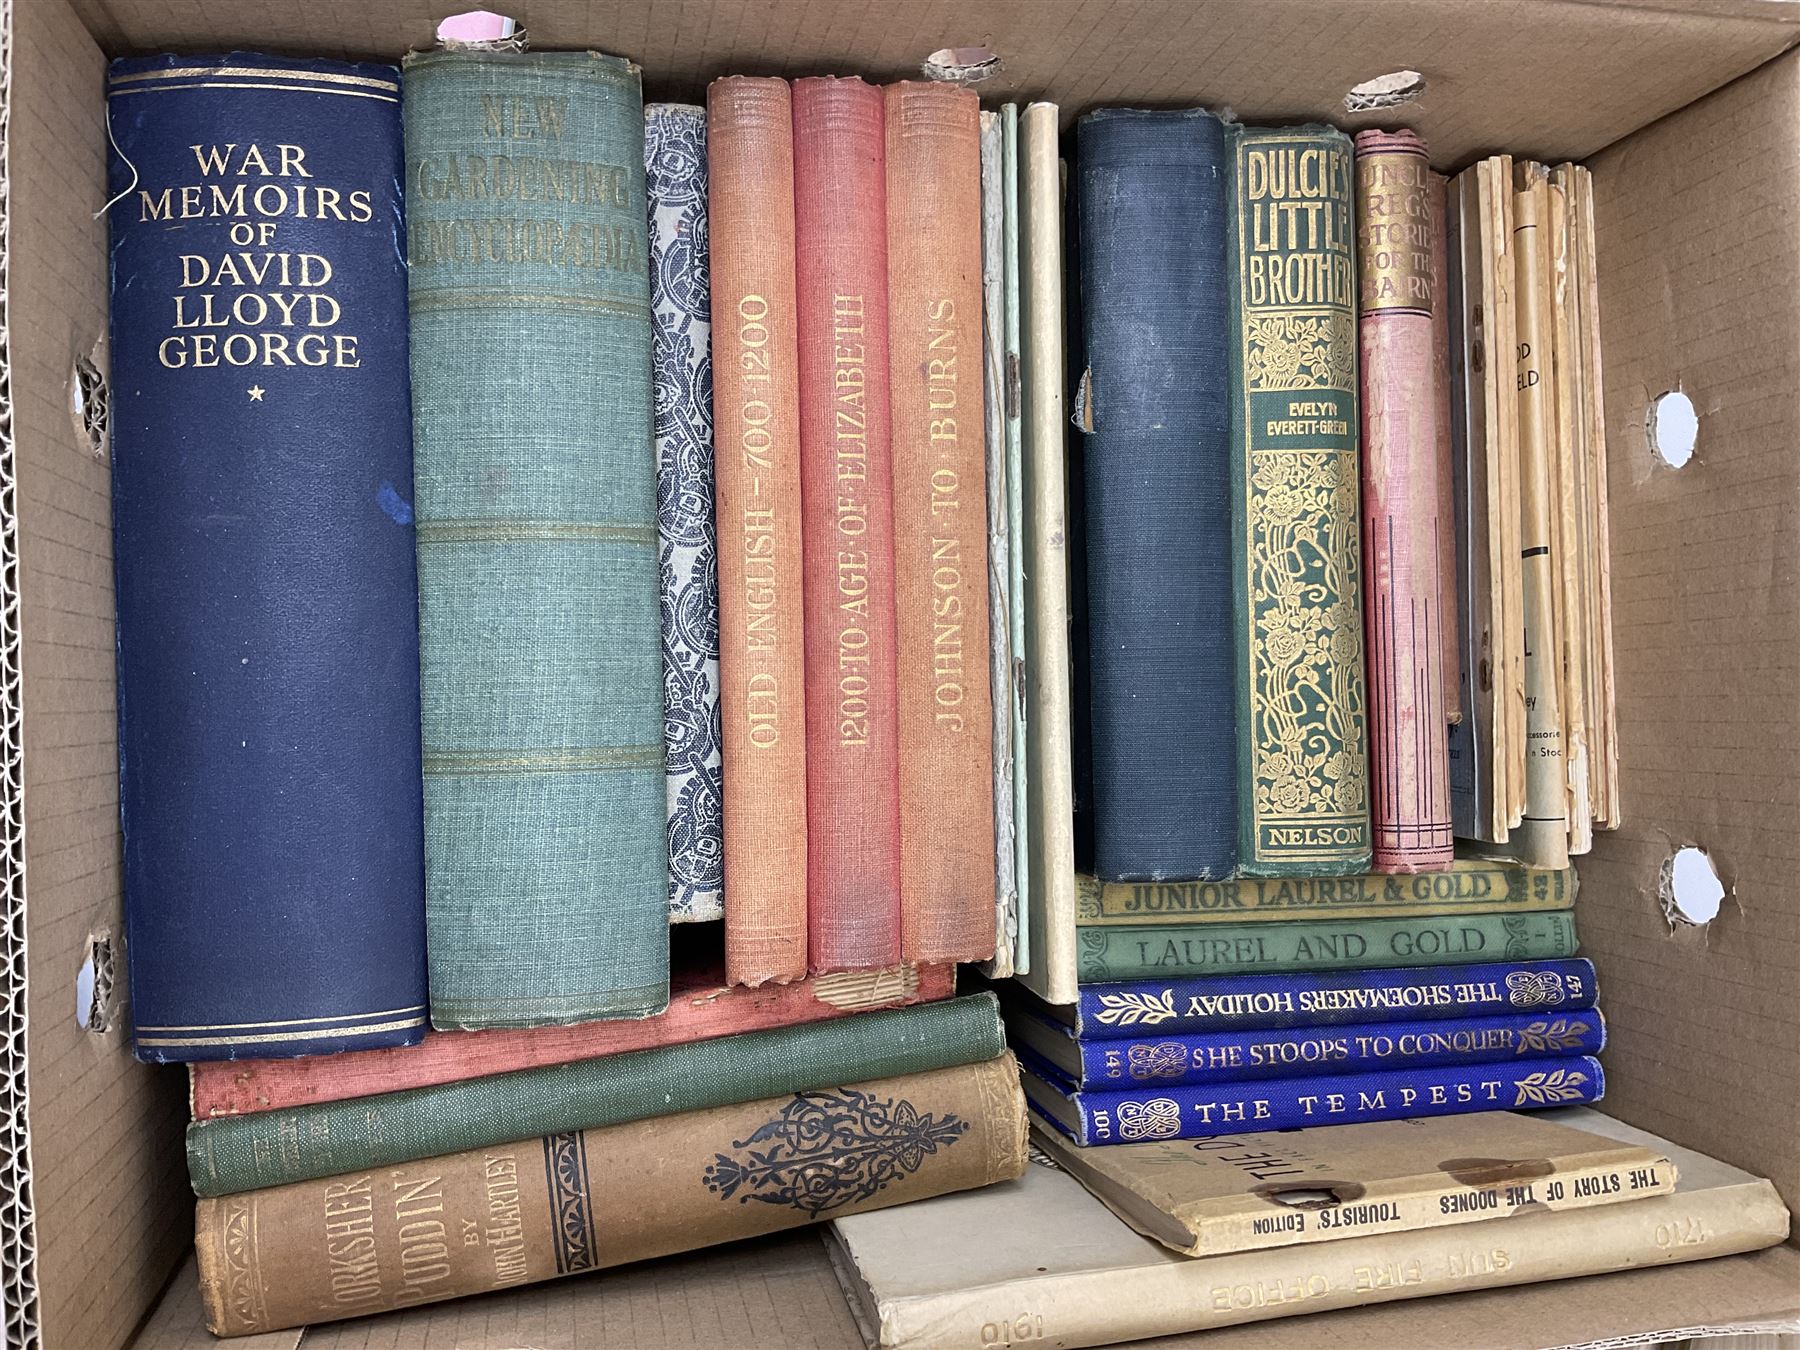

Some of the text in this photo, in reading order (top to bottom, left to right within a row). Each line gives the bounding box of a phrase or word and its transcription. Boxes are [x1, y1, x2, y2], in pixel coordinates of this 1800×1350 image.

[482, 94, 568, 141] NEW
[189, 143, 314, 178] WAR
[249, 146, 349, 202] DULCIE'S
[418, 154, 632, 209] GARDENING
[138, 184, 373, 223] MEMOIRS
[230, 222, 277, 246] OF
[253, 201, 348, 253] LITTLE
[178, 253, 333, 288] DAVID
[250, 253, 351, 307] BROTHER
[172, 293, 341, 329] LLOYD
[159, 333, 361, 369] GEORGE
[1289, 402, 1338, 417] EVELYN
[834, 293, 870, 747] 1200 TO AGE OF ELIZABETH
[928, 299, 964, 732] JOHNSON TO BURNS
[744, 509, 776, 653] ENGLISH
[748, 672, 778, 748] OLD
[1541, 747, 1562, 758] Stoc
[1268, 827, 1362, 846] NELSON
[1125, 873, 1492, 911] JUNIOR LAUREL & GOLD
[1135, 927, 1486, 967] LAUREL AND GOLD
[1185, 992, 1294, 1017] HOLIDAY
[1299, 984, 1451, 1013] SHOEMAKER'S
[1454, 982, 1502, 1003] THE
[1566, 975, 1584, 999] 147
[1104, 1049, 1121, 1078] 149
[1192, 1045, 1242, 1069] SHE
[1250, 1038, 1348, 1066] STOOPS
[1355, 1036, 1393, 1058] TO
[1399, 1028, 1513, 1055] CONQUER
[1195, 1100, 1271, 1124] THE
[1298, 1081, 1502, 1115] TEMPEST
[1093, 1109, 1111, 1139] 100
[1217, 1151, 1304, 1180] THE
[485, 1153, 523, 1247] HARTLEY
[1439, 1168, 1660, 1215] THE STORY OF THE DOONES
[462, 1218, 480, 1247] BY
[1253, 1202, 1400, 1235] TOURISTS' EDITION
[1655, 1216, 1706, 1249] 1710
[1212, 1249, 1513, 1314] SUN FIRE OFFICE
[980, 1311, 1043, 1347] 1910
